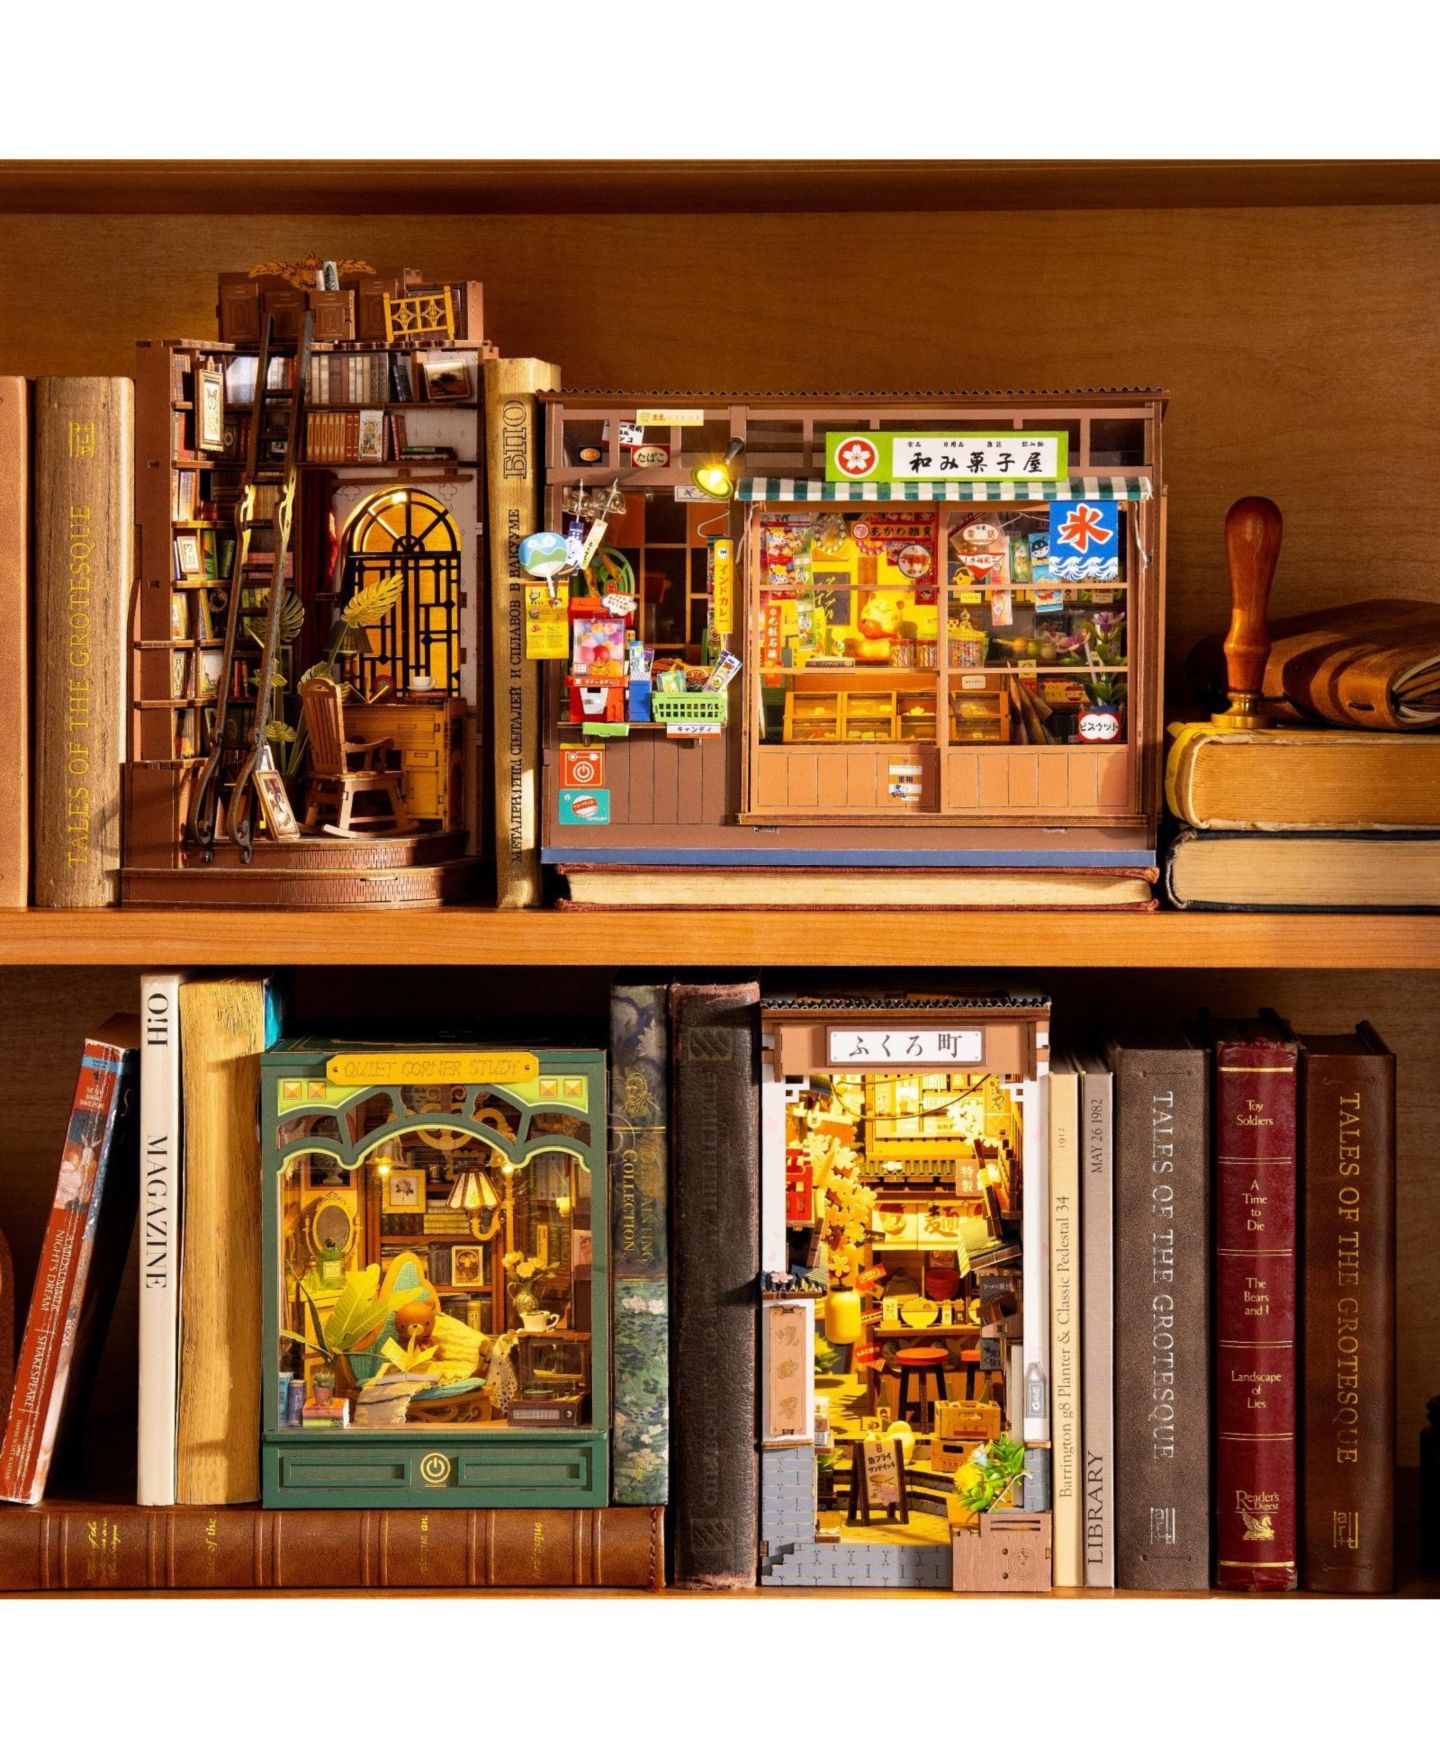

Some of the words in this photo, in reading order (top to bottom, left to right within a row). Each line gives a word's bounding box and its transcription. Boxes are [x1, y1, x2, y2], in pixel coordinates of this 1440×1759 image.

[503, 400, 527, 479] БПО
[636, 451, 665, 463] たばこ
[908, 452, 1044, 473] 和み菓子屋
[1057, 503, 1114, 554] 氷
[69, 505, 96, 662] GROTESQUE
[68, 675, 90, 732] THE
[68, 744, 89, 774] OF
[67, 786, 89, 867] TALES
[849, 1033, 963, 1058] ふくろ町
[344, 1061, 397, 1078] QUIET
[400, 1060, 462, 1077] CORNER
[469, 1058, 520, 1076] STUDY
[1091, 1098, 1103, 1126] 1982
[1236, 1115, 1274, 1126] Soldiers
[1246, 1100, 1264, 1113] Toy
[1091, 1127, 1103, 1143] 26
[1152, 1091, 1174, 1174] TALES
[1340, 1093, 1360, 1176] TALES
[1091, 1143, 1103, 1174] MAY
[1242, 1193, 1268, 1205] Time
[1250, 1180, 1259, 1190] A
[146, 1135, 169, 1289] MAGAZINE
[622, 1149, 639, 1252] COLLECTION
[1056, 1195, 1070, 1212] 34
[1152, 1185, 1174, 1219] OF
[1250, 1207, 1261, 1218] to
[1339, 1187, 1360, 1222] OF
[1247, 1220, 1264, 1231] Die
[48, 1229, 65, 1276] NIGHT'S
[1055, 1216, 1070, 1272] Pedestal
[1152, 1229, 1174, 1283] THE
[1339, 1232, 1359, 1287] THE
[41, 1276, 55, 1311] DREAM
[1244, 1290, 1270, 1302] Bears
[1245, 1277, 1266, 1289] The
[1056, 1275, 1071, 1325] Classic
[1244, 1305, 1264, 1316] and
[1057, 1329, 1070, 1343] &
[24, 1335, 48, 1410] SHAKESPEARE
[1058, 1348, 1072, 1397] Planter
[1148, 1294, 1175, 1460] GROTESQUE
[1231, 1370, 1282, 1384] Landscape
[1333, 1297, 1359, 1463] GROTESQUE
[1247, 1398, 1266, 1409] Lies
[1251, 1385, 1261, 1395] of
[1059, 1422, 1074, 1498] Barrington
[1087, 1451, 1104, 1566] LIBRARY
[1235, 1490, 1279, 1511] Reader's
[1254, 1502, 1279, 1512] Digest
[205, 1518, 217, 1536] the
